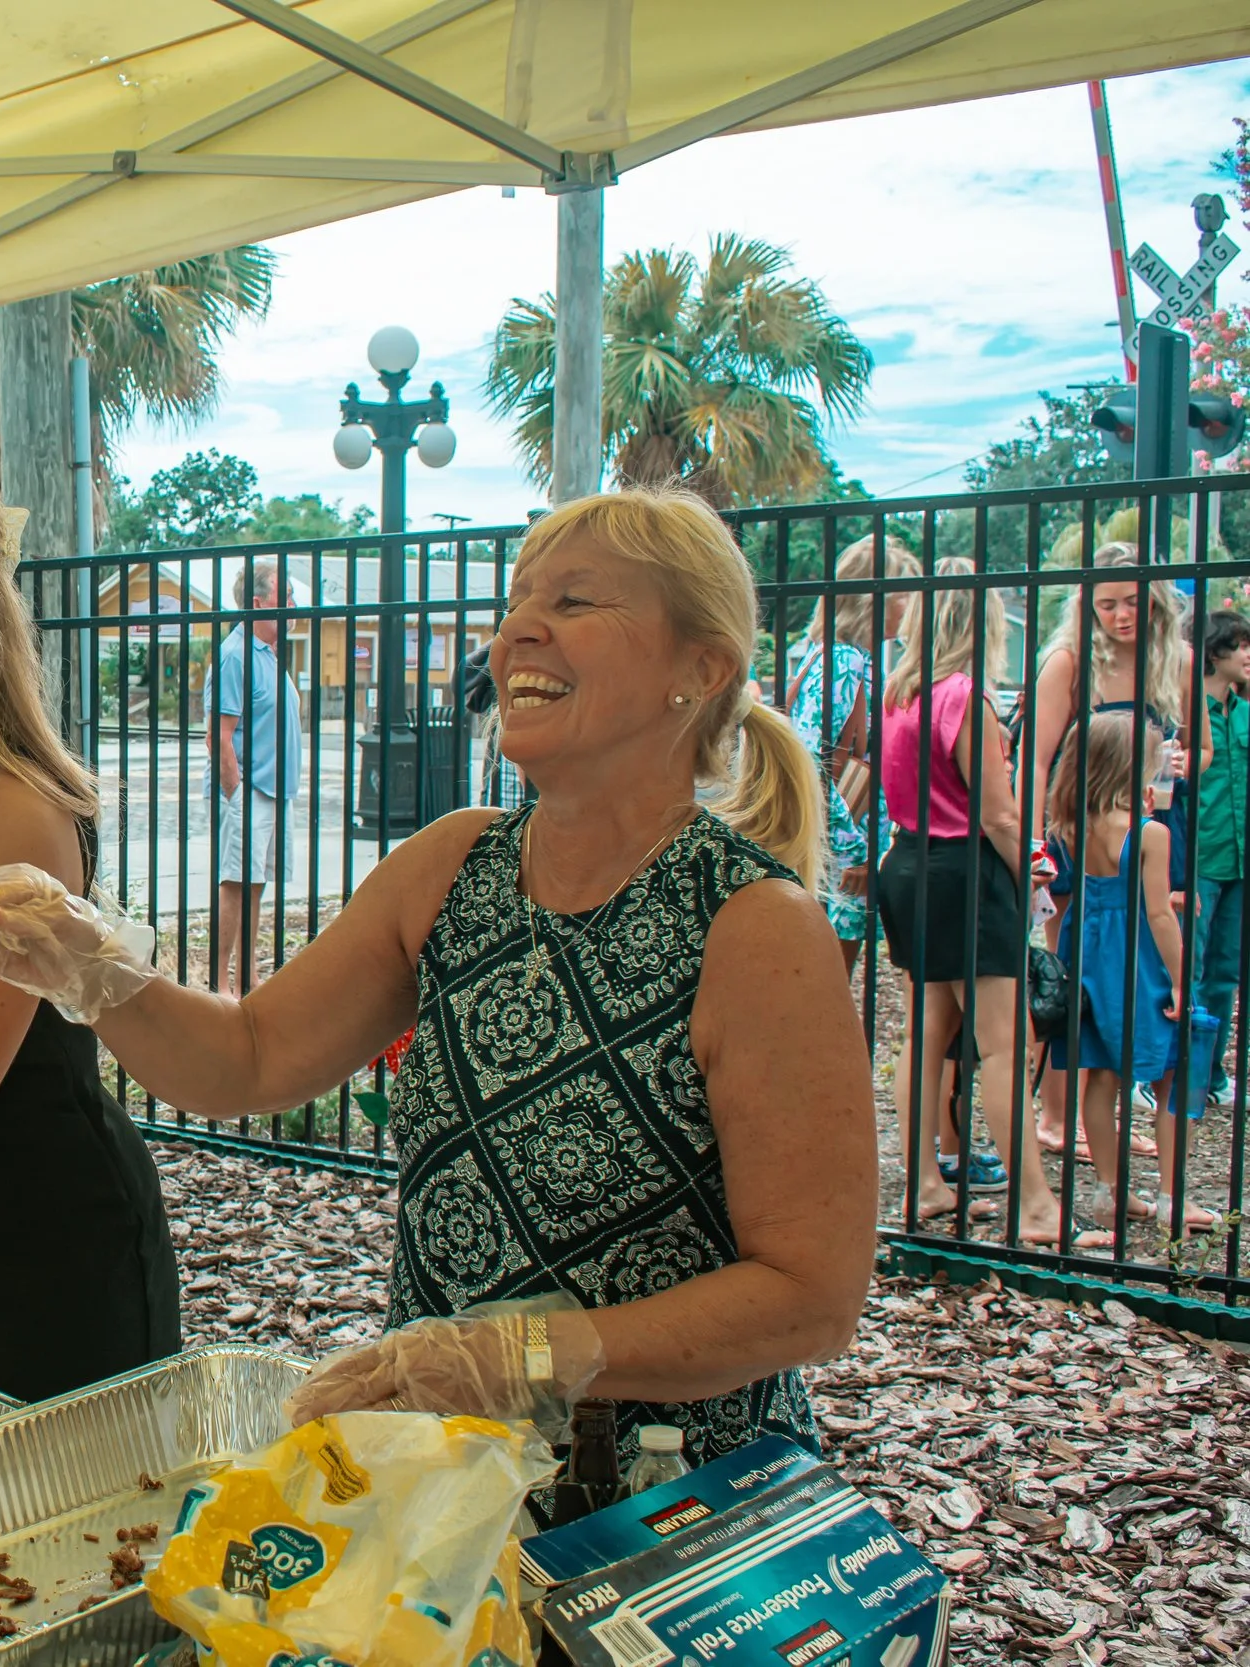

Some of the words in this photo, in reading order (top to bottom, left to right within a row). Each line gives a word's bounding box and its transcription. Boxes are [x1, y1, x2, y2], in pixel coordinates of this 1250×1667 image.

[1131, 249, 1169, 294] RAIL
[1132, 244, 1227, 350] OSSING
[728, 1470, 769, 1490] Quality
[763, 1450, 808, 1474] Premium
[653, 1503, 713, 1534] KIRKLAND
[840, 1533, 903, 1576] Reynolds
[890, 1563, 934, 1594] Premium
[556, 1582, 622, 1623] RK611
[726, 1573, 833, 1635] Foodservice
[856, 1585, 897, 1610] Quality
[690, 1626, 737, 1661] Foil
[786, 1629, 844, 1667] KIRKLAND
